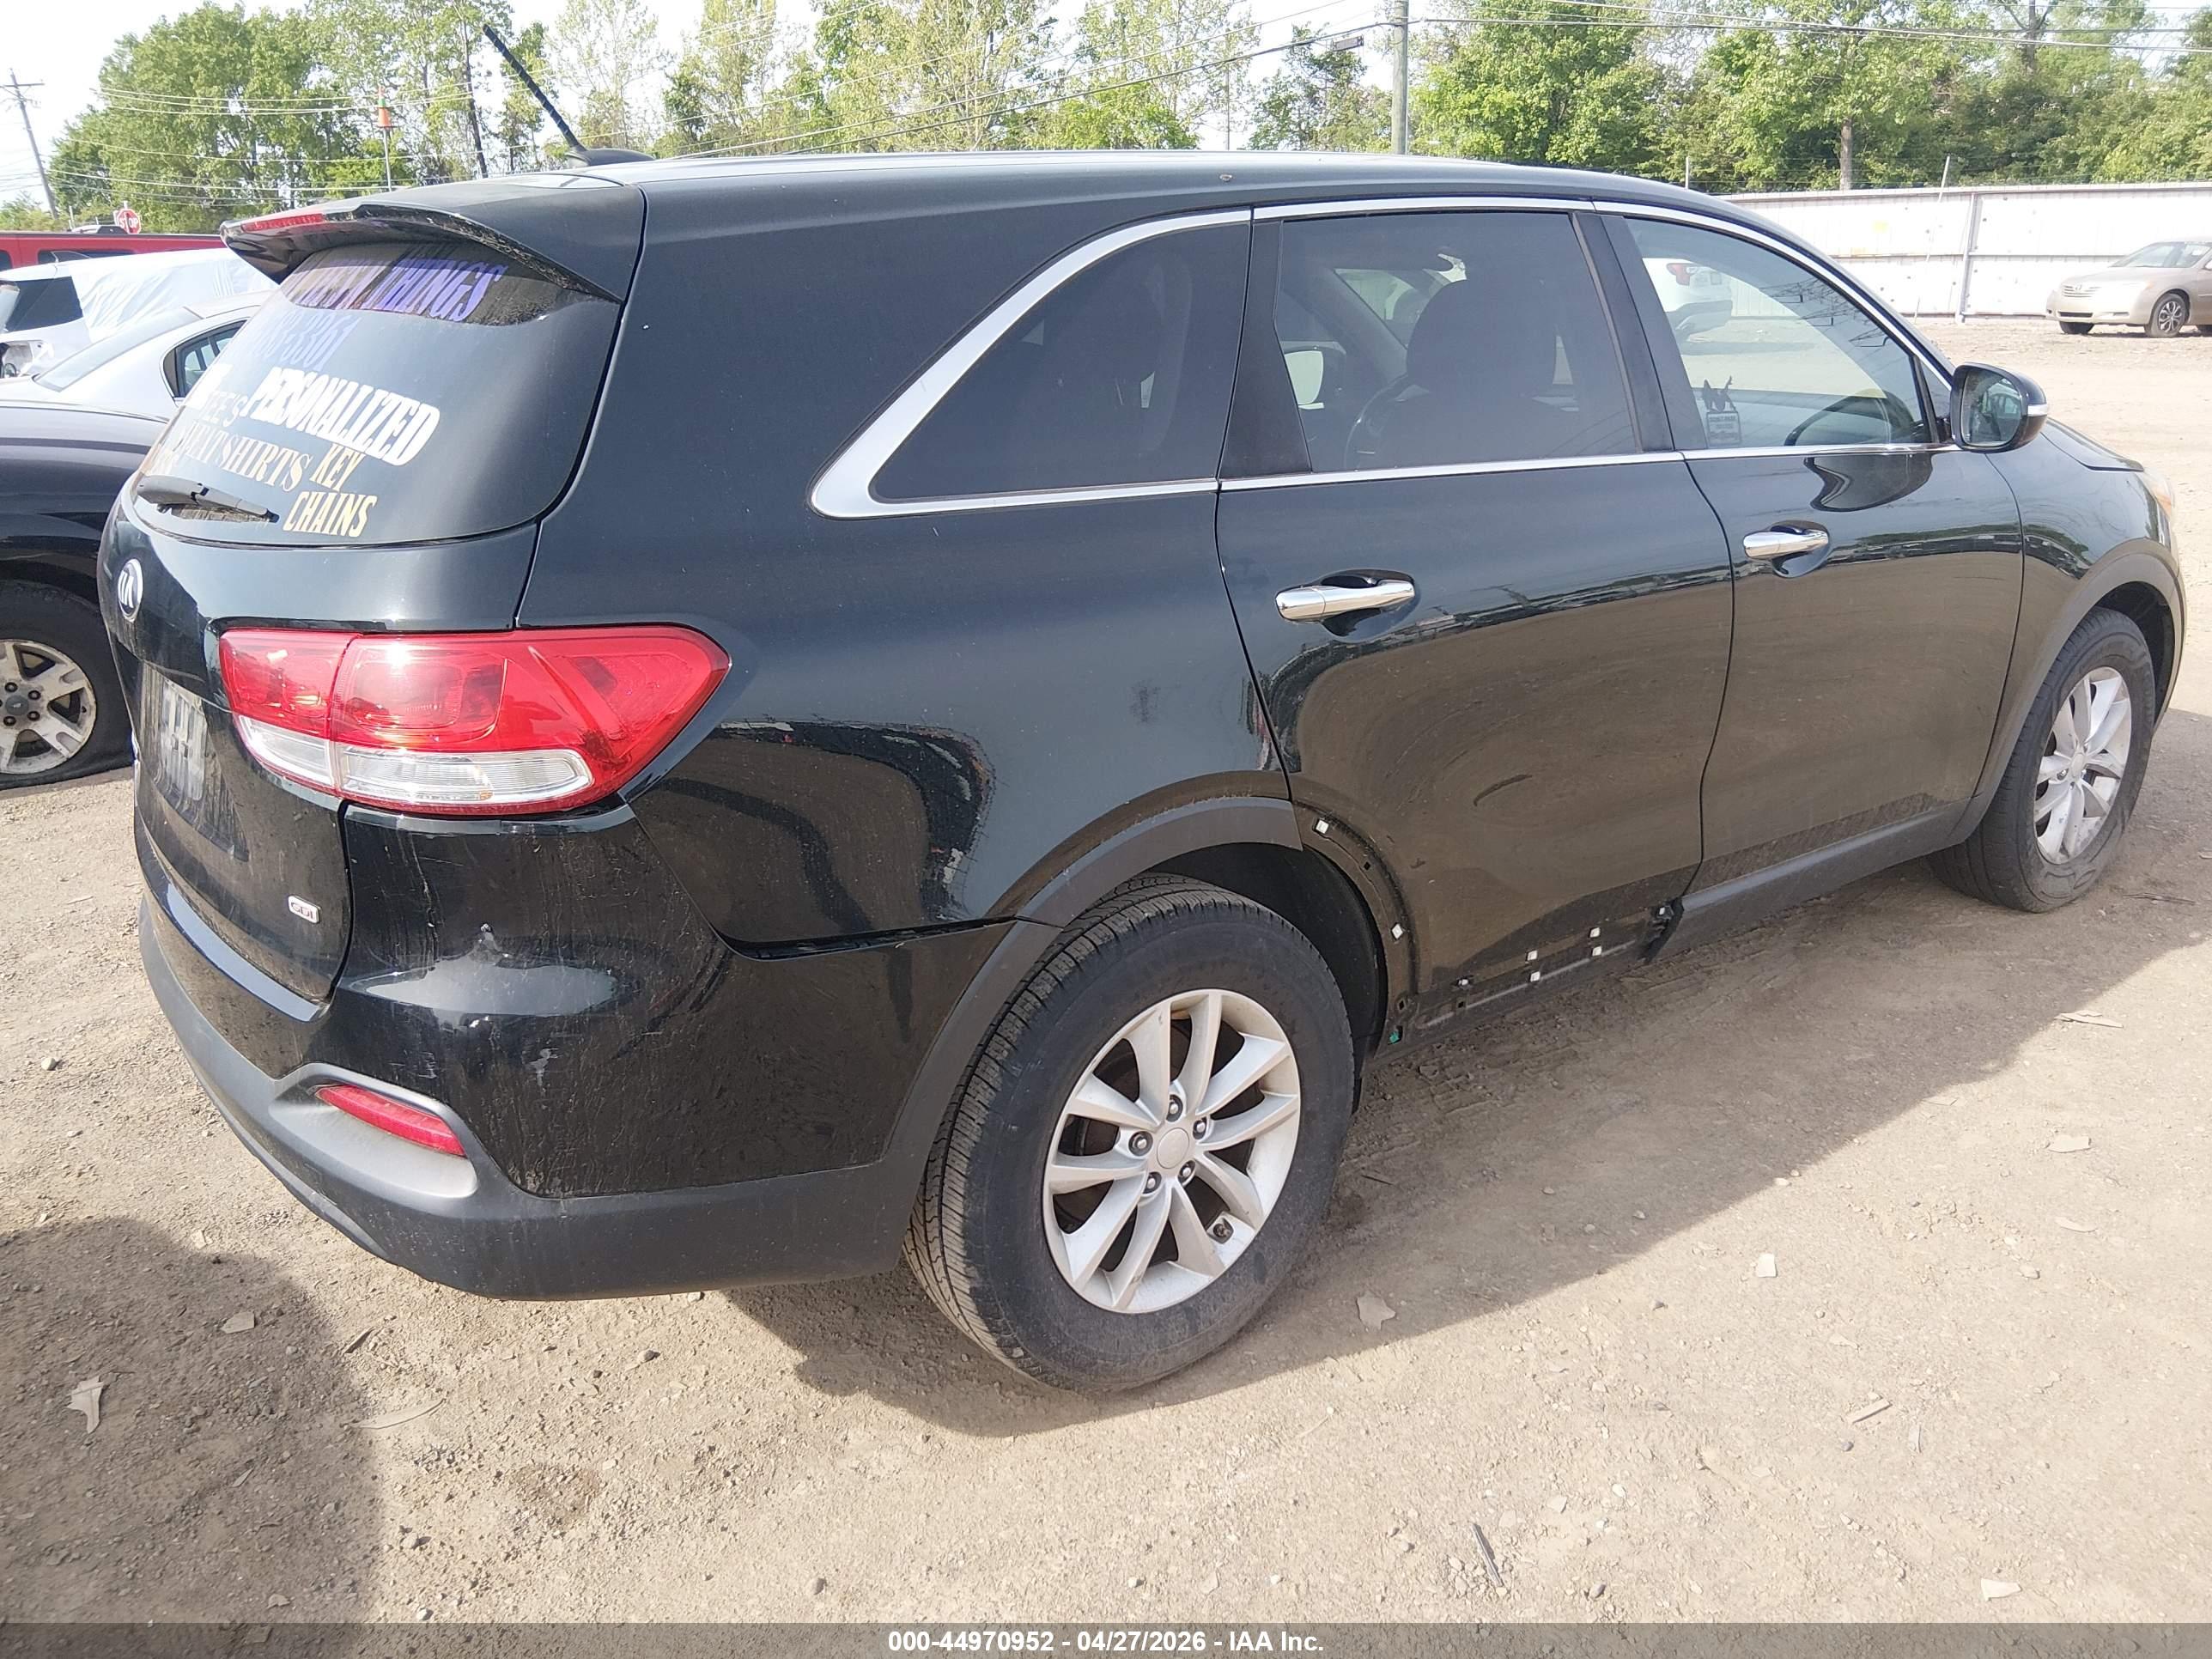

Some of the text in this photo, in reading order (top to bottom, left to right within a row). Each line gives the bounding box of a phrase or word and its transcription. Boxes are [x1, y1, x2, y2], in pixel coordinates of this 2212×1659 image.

[118, 216, 138, 229] SOP
[362, 257, 508, 322] THINGS
[239, 367, 441, 466] PERSONALIZED
[309, 442, 367, 492] KEY
[283, 490, 378, 538] CHAINS
